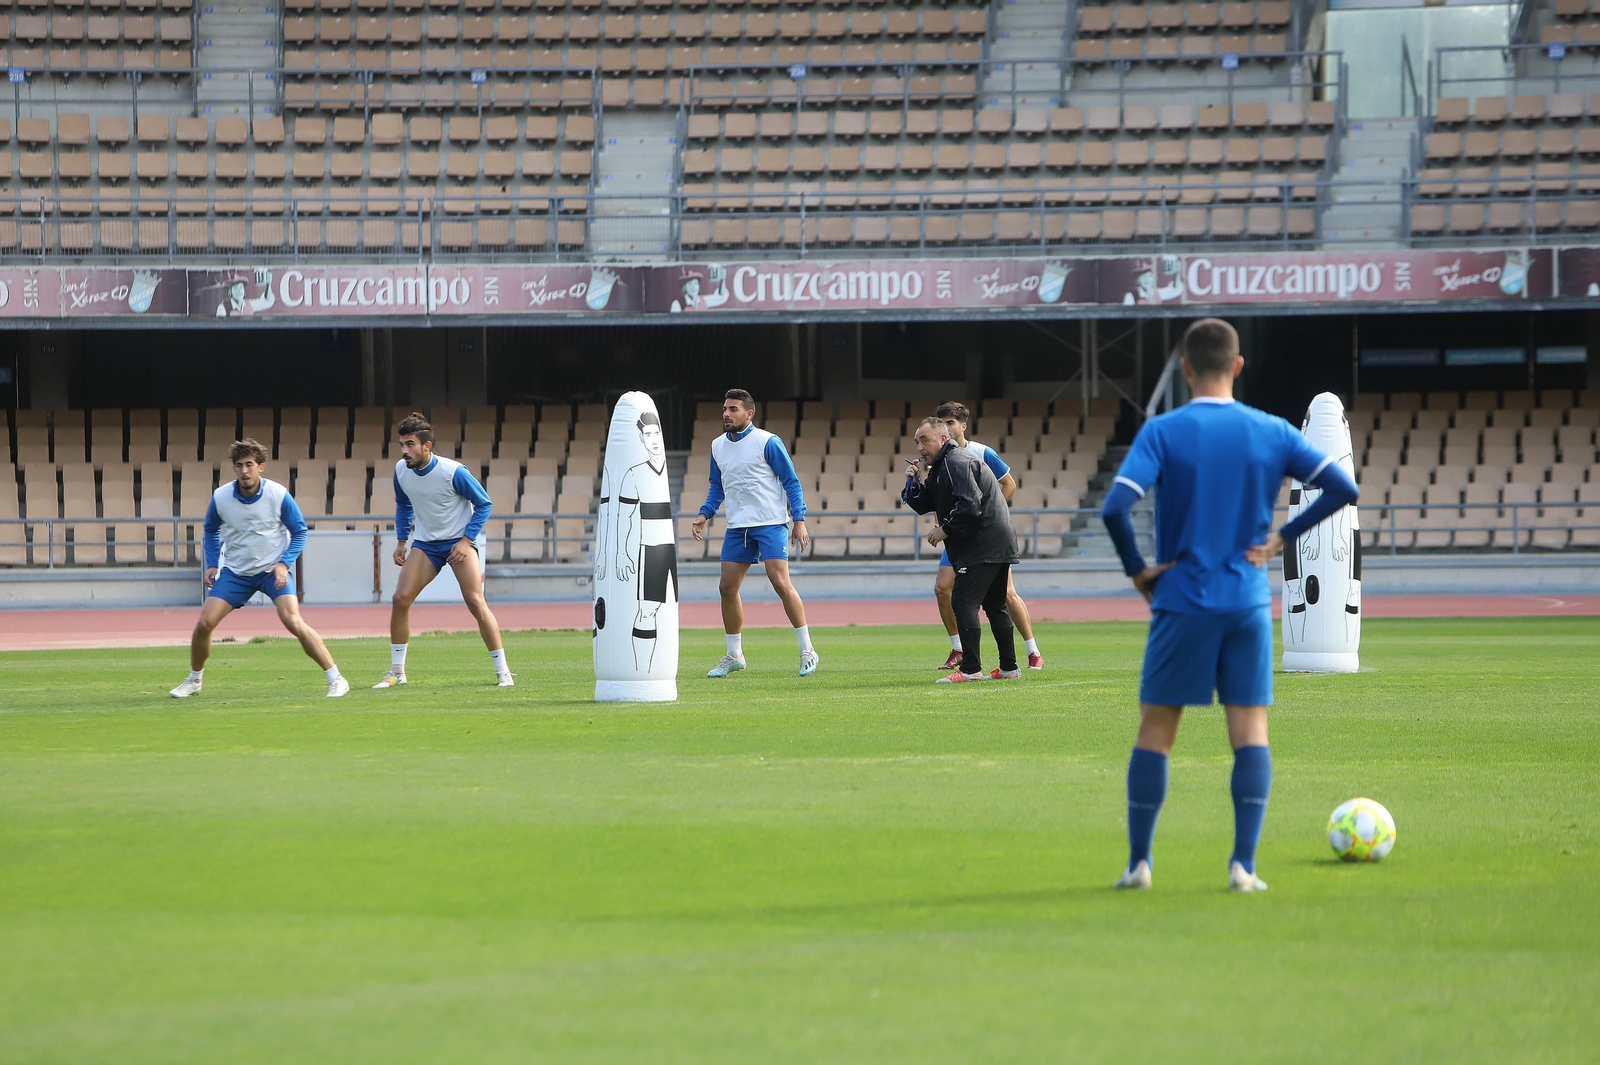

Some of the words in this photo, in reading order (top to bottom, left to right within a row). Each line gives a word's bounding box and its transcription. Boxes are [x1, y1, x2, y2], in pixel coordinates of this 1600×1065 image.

[279, 270, 472, 312] Cruzcampo
[484, 276, 499, 306] SIN
[733, 265, 924, 306] Cruzcampo
[936, 270, 952, 299] SIN
[1187, 258, 1382, 298] Cruzcampo
[1394, 261, 1412, 292] SIN
[24, 278, 39, 309] SIN
[70, 290, 109, 309] Xerez
[111, 285, 129, 302] CD
[529, 288, 567, 307] Xerez
[568, 282, 588, 299] CD
